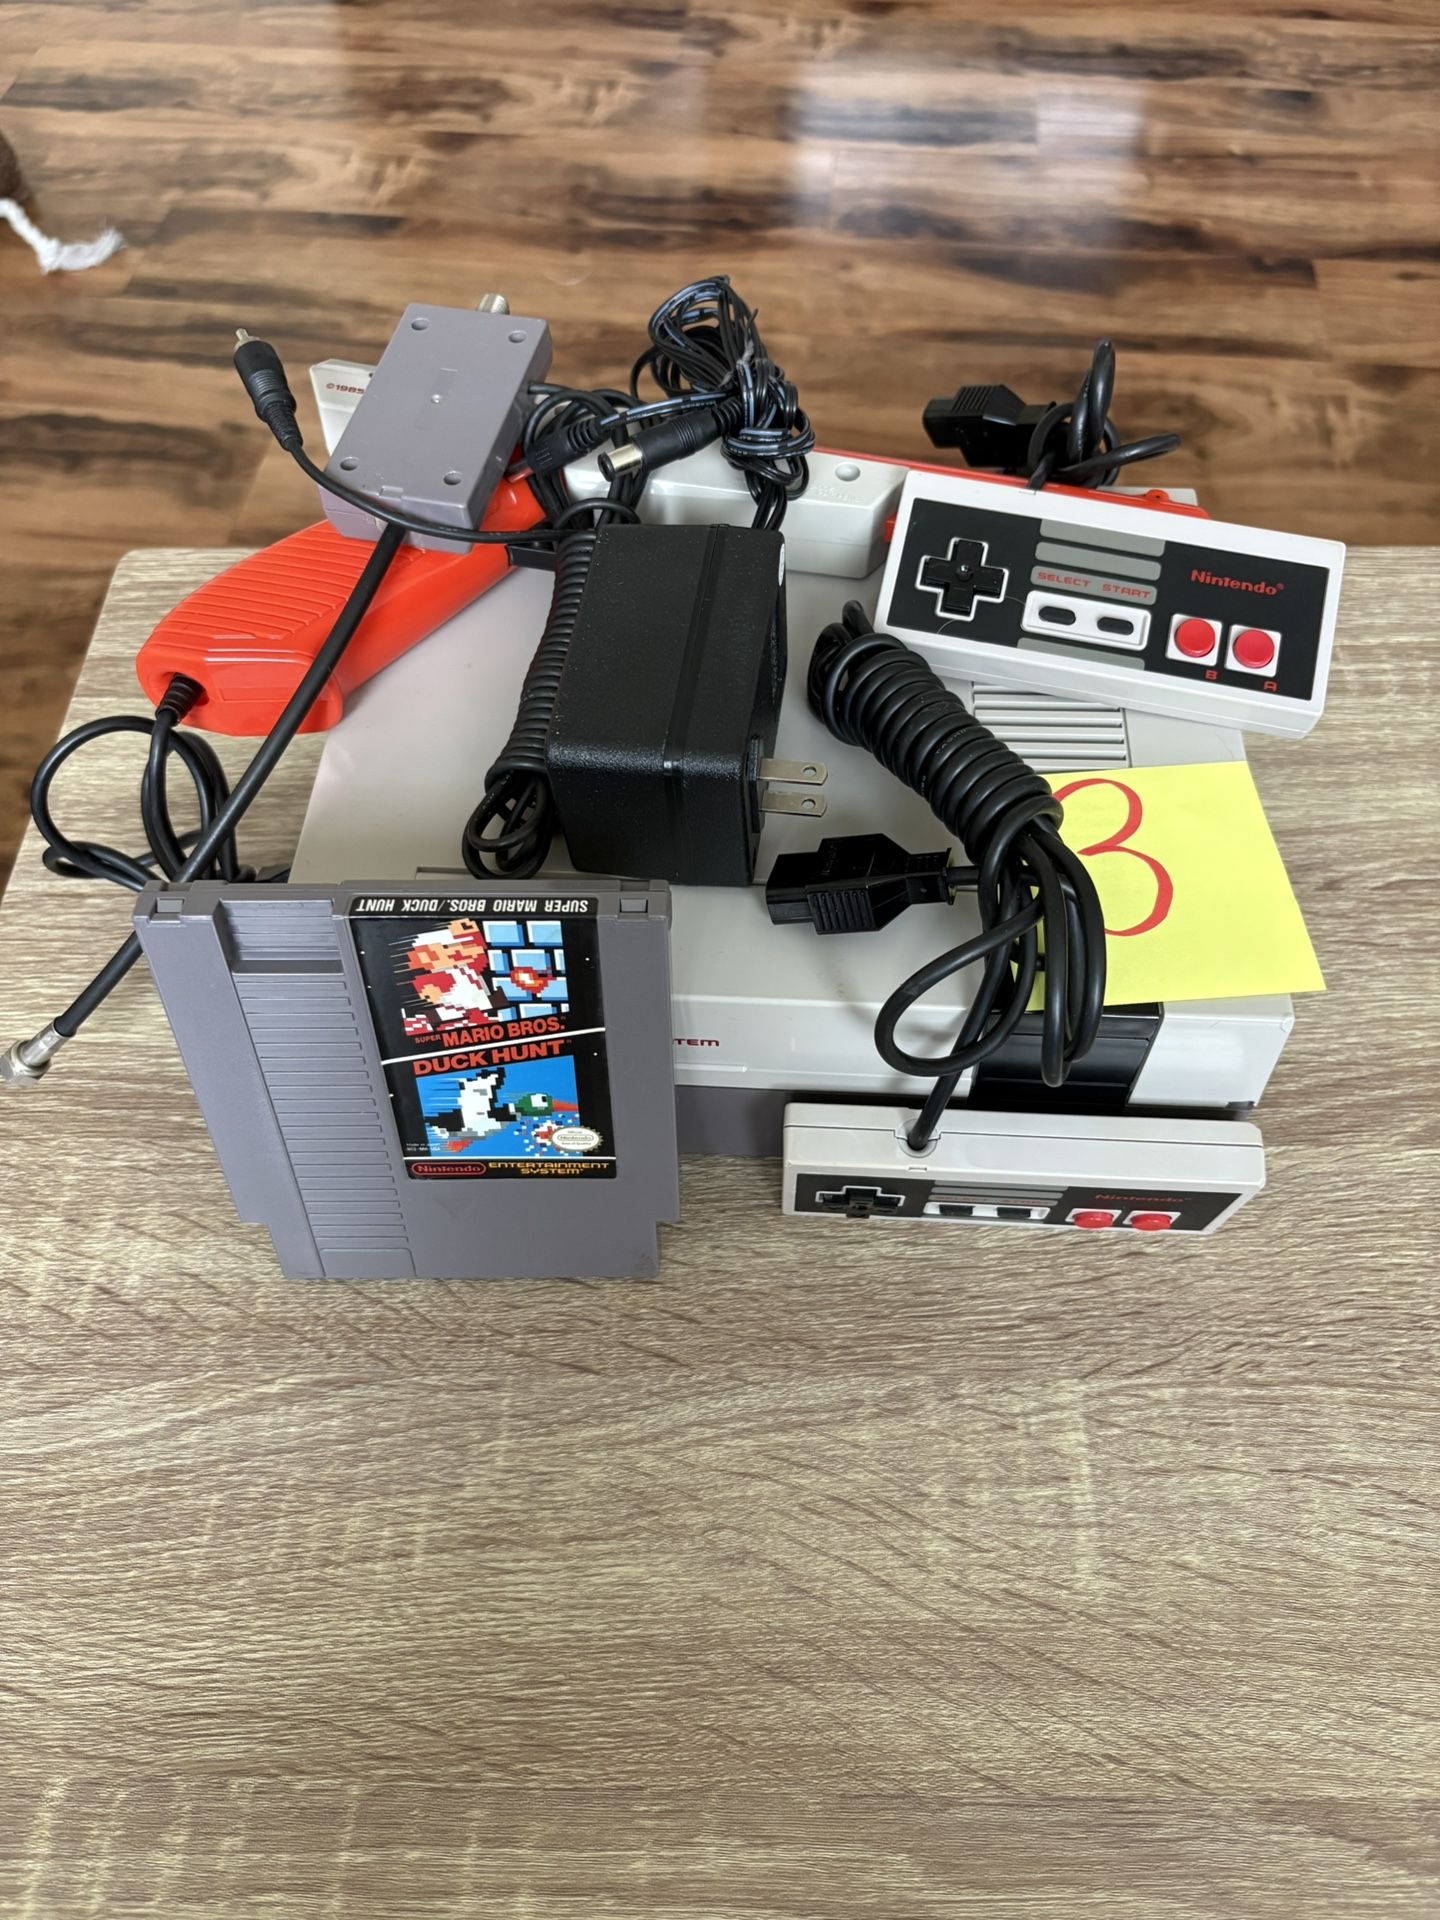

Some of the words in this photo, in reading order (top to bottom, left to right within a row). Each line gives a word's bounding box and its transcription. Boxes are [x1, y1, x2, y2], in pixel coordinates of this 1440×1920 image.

[1037, 571, 1091, 588] SELECT
[1101, 582, 1151, 599] START
[1204, 669, 1217, 680] B
[1263, 681, 1277, 692] A
[1052, 778, 1174, 937] 3
[355, 898, 396, 912] HUNT
[493, 899, 538, 912] MARIO
[544, 899, 589, 913] SUPER
[414, 1034, 442, 1045] SUPER
[442, 1024, 505, 1048] MARIO
[507, 1015, 566, 1038] BROS.
[412, 1052, 486, 1076] DUCK
[491, 1039, 565, 1065] HUNT
[417, 1164, 482, 1173] Nintendo
